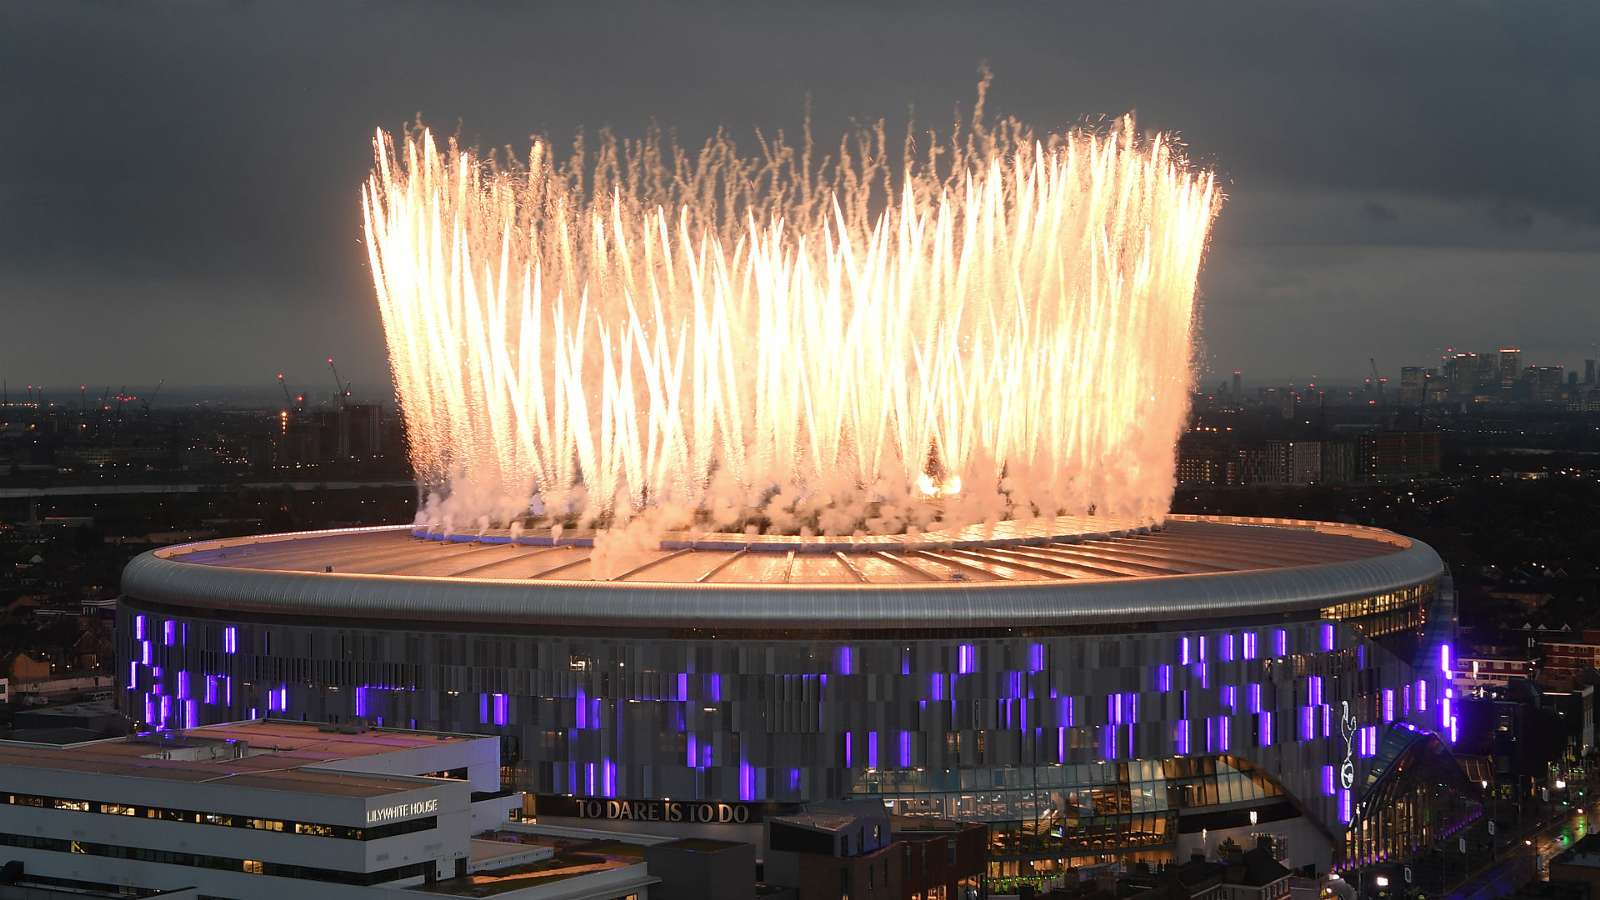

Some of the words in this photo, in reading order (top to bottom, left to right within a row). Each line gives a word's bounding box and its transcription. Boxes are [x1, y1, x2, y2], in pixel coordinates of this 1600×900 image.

[367, 804, 409, 823] LILYWHITE
[410, 799, 438, 816] HOUSE
[576, 800, 601, 818] TO
[607, 800, 659, 821] DARE
[664, 801, 682, 821] IS
[688, 803, 713, 823] TO
[719, 803, 749, 823] DO
